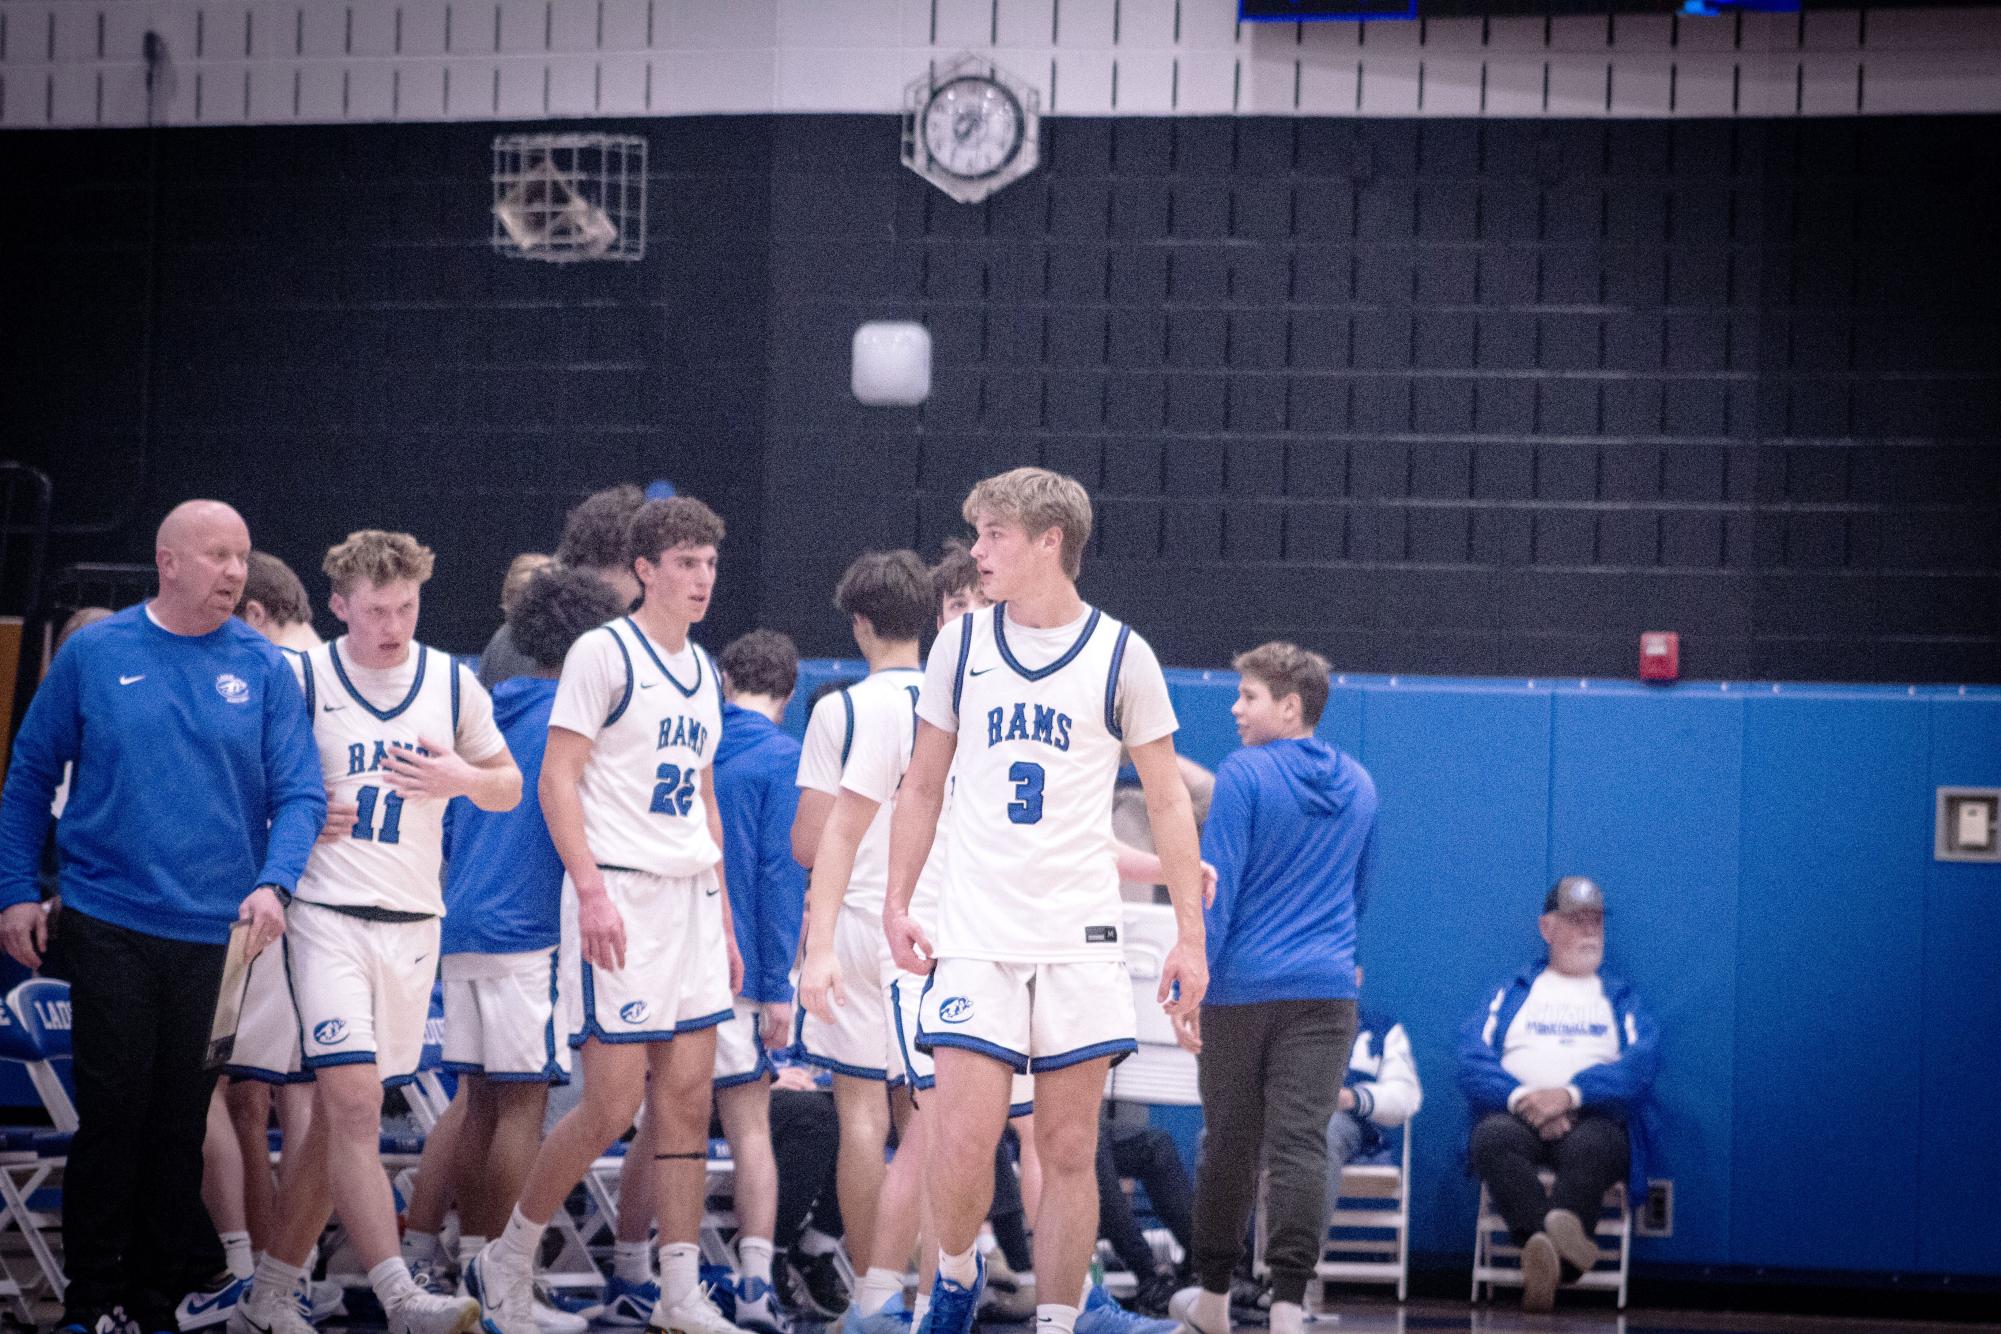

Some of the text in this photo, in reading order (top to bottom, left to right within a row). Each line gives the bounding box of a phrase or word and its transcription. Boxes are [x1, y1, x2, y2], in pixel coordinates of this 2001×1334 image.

[987, 702, 1072, 752] RAMS
[347, 740, 429, 776] RA
[351, 785, 404, 844] 11
[1007, 761, 1045, 825] 3
